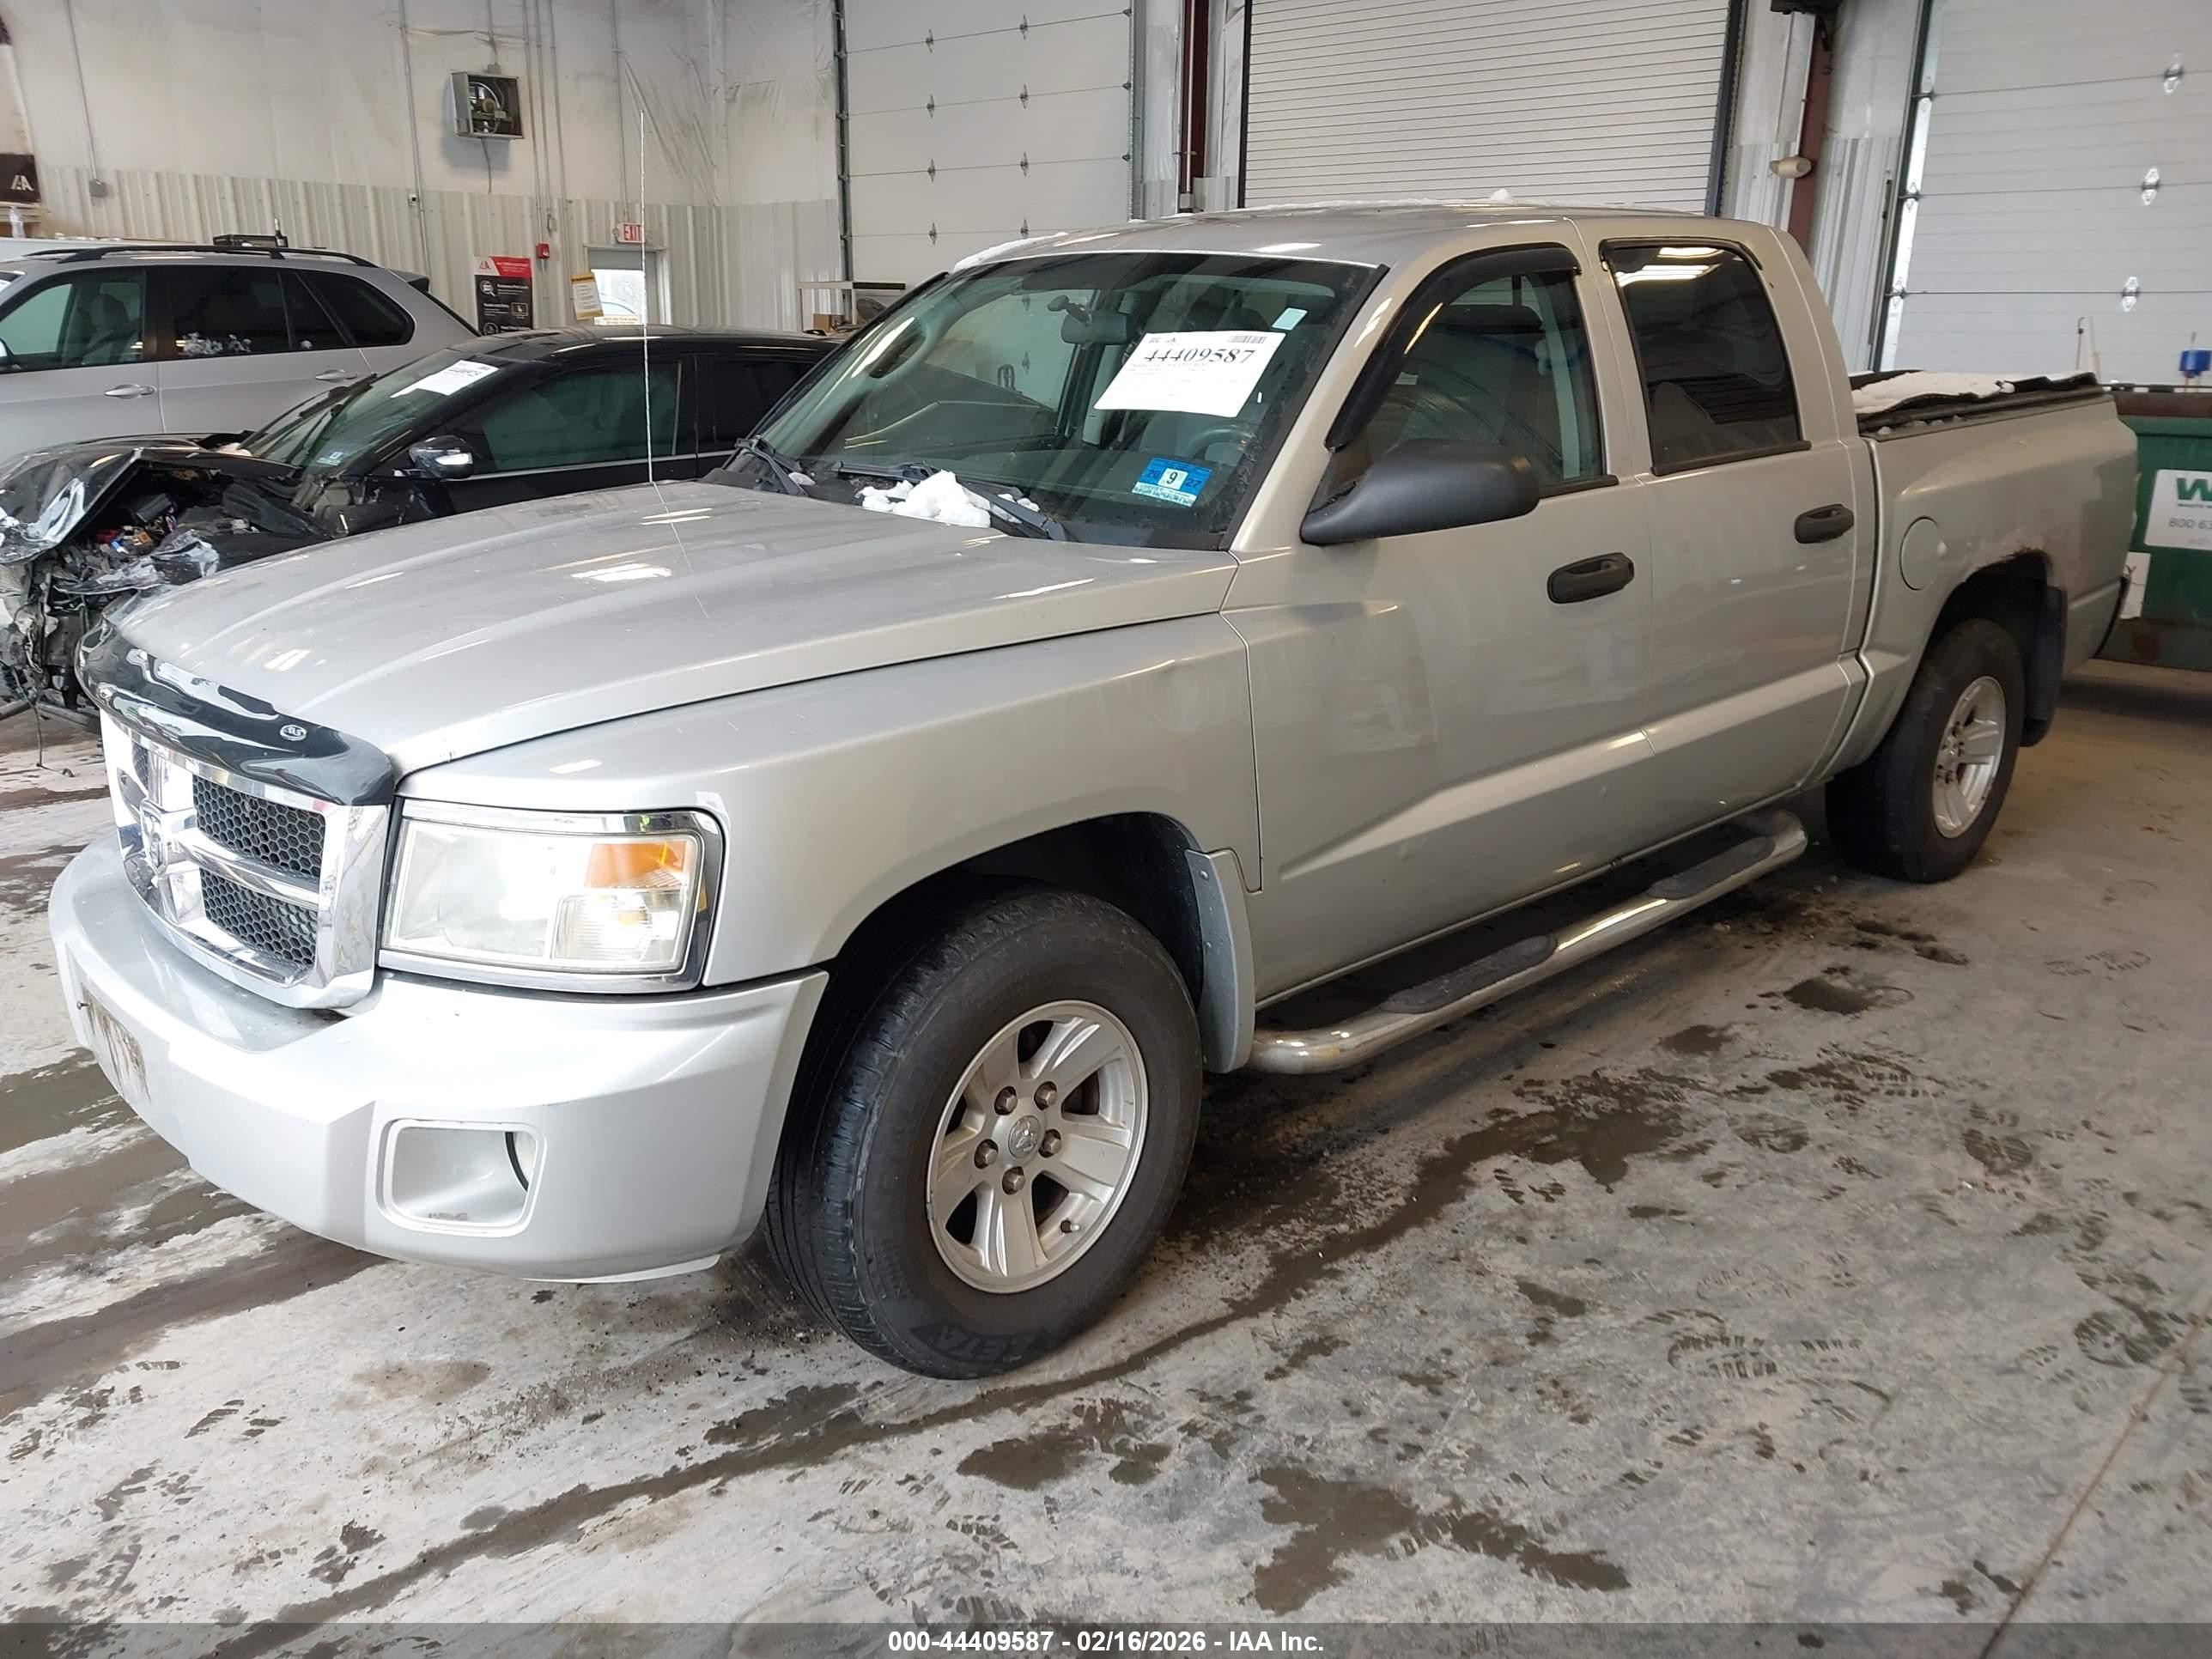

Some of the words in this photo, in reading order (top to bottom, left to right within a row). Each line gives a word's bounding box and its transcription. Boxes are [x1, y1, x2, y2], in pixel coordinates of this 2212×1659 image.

[623, 223, 641, 240] EXIT
[1144, 348, 1256, 364] 44409587
[1146, 469, 1161, 479] 20
[1166, 471, 1178, 484] 9
[1185, 477, 1202, 488] 27
[2169, 518, 2195, 528] 800
